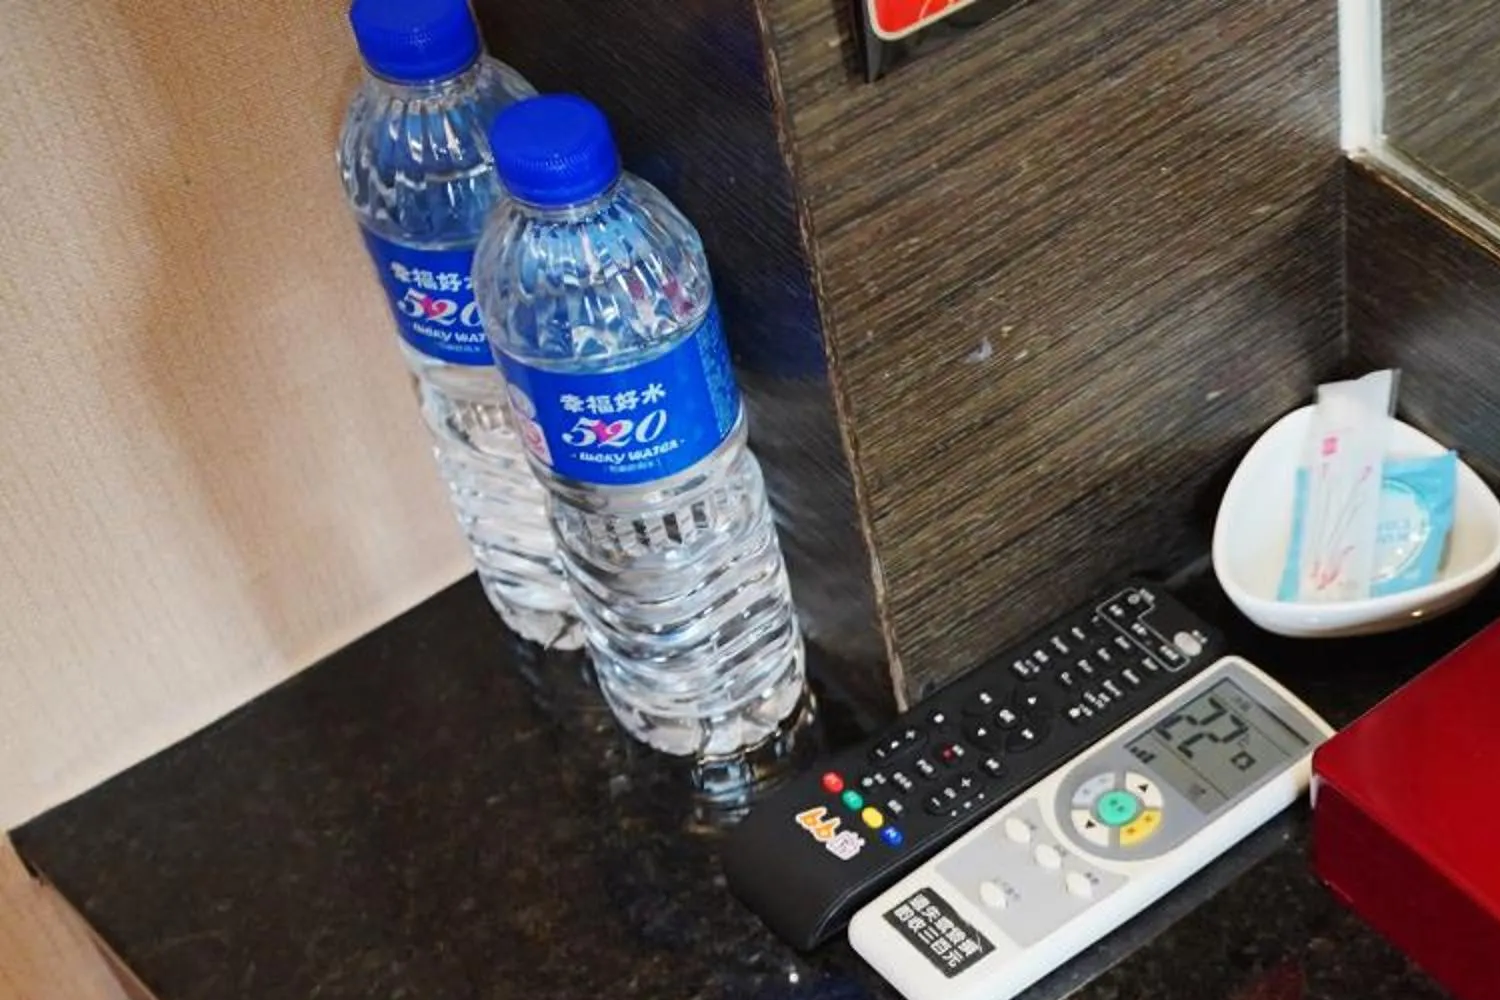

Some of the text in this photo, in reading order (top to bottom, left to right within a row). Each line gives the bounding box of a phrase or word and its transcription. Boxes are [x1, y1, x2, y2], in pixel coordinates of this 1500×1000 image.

[560, 383, 667, 414] 幸福好水
[561, 408, 667, 448] 520
